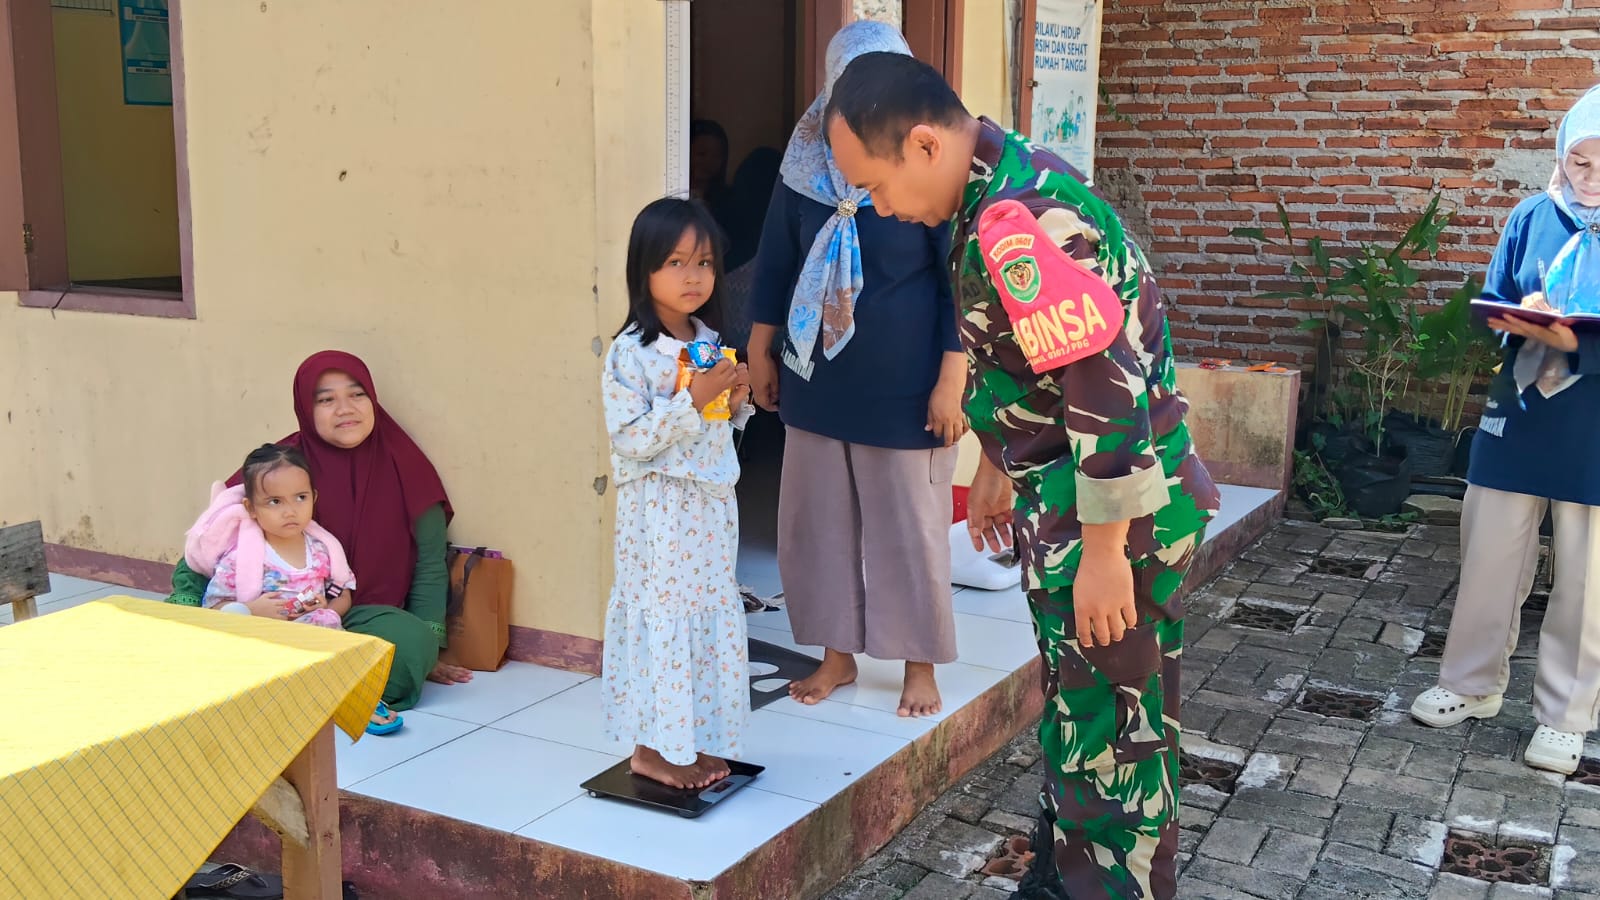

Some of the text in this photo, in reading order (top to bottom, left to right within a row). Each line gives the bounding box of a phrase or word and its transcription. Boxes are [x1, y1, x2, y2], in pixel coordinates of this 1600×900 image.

[1061, 26, 1080, 39] HIDUP
[1051, 40, 1066, 55] DAN
[1067, 42, 1088, 56] SEHAT
[1035, 55, 1087, 72] RUMAH TANGGA
